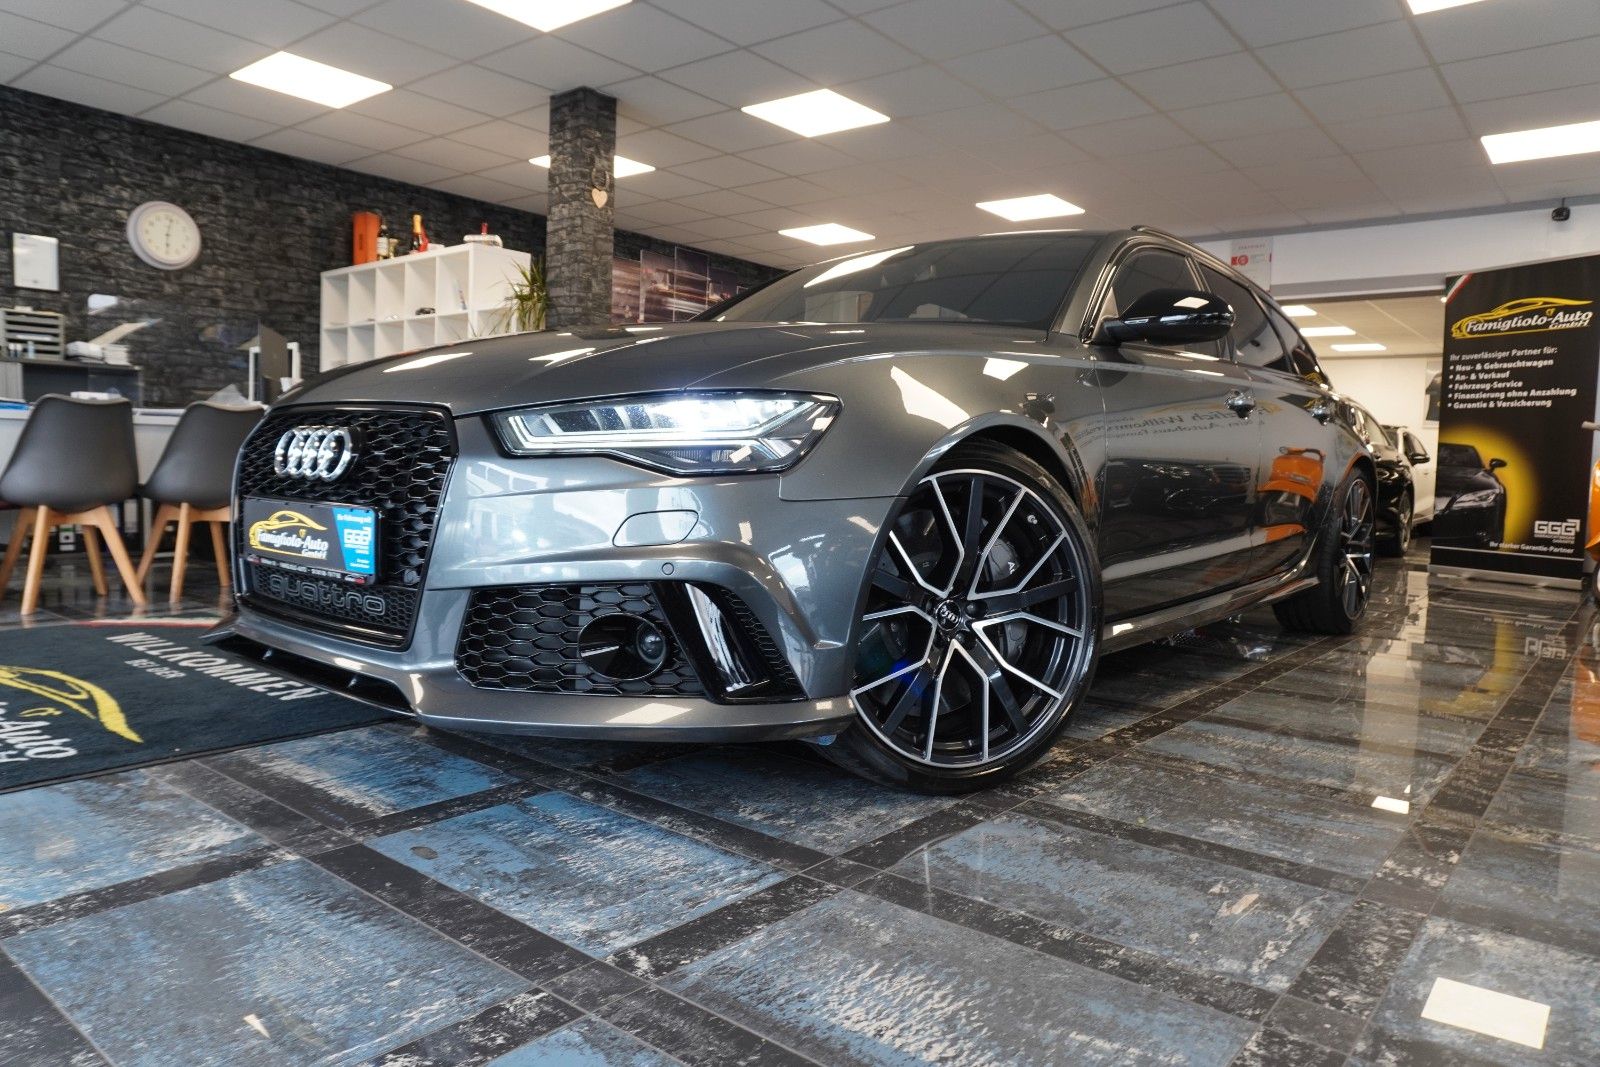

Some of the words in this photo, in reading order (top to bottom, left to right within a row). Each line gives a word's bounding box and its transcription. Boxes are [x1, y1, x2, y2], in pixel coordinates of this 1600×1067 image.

[1466, 310, 1593, 332] Famigliolo-Auto
[1548, 319, 1590, 330] GmbH
[1461, 350, 1510, 361] zuverlässiger
[1511, 348, 1542, 357] Partner
[1542, 346, 1558, 354] für:
[1483, 359, 1554, 370] Gebrauchtwagen
[1455, 373, 1469, 381] An-
[1478, 370, 1511, 380] Verkauf
[1454, 380, 1523, 390] Fahrzeug-Service
[1453, 391, 1506, 400] Finanzierung
[1506, 390, 1529, 398] ohne
[1529, 387, 1578, 397] Anzahlung
[1453, 401, 1488, 409] Garantie
[1488, 400, 1496, 408] &
[1496, 399, 1552, 408] Versicherung
[1534, 519, 1577, 536] GGG
[270, 574, 385, 616] quattro
[105, 632, 329, 701] WILLKOMMEN
